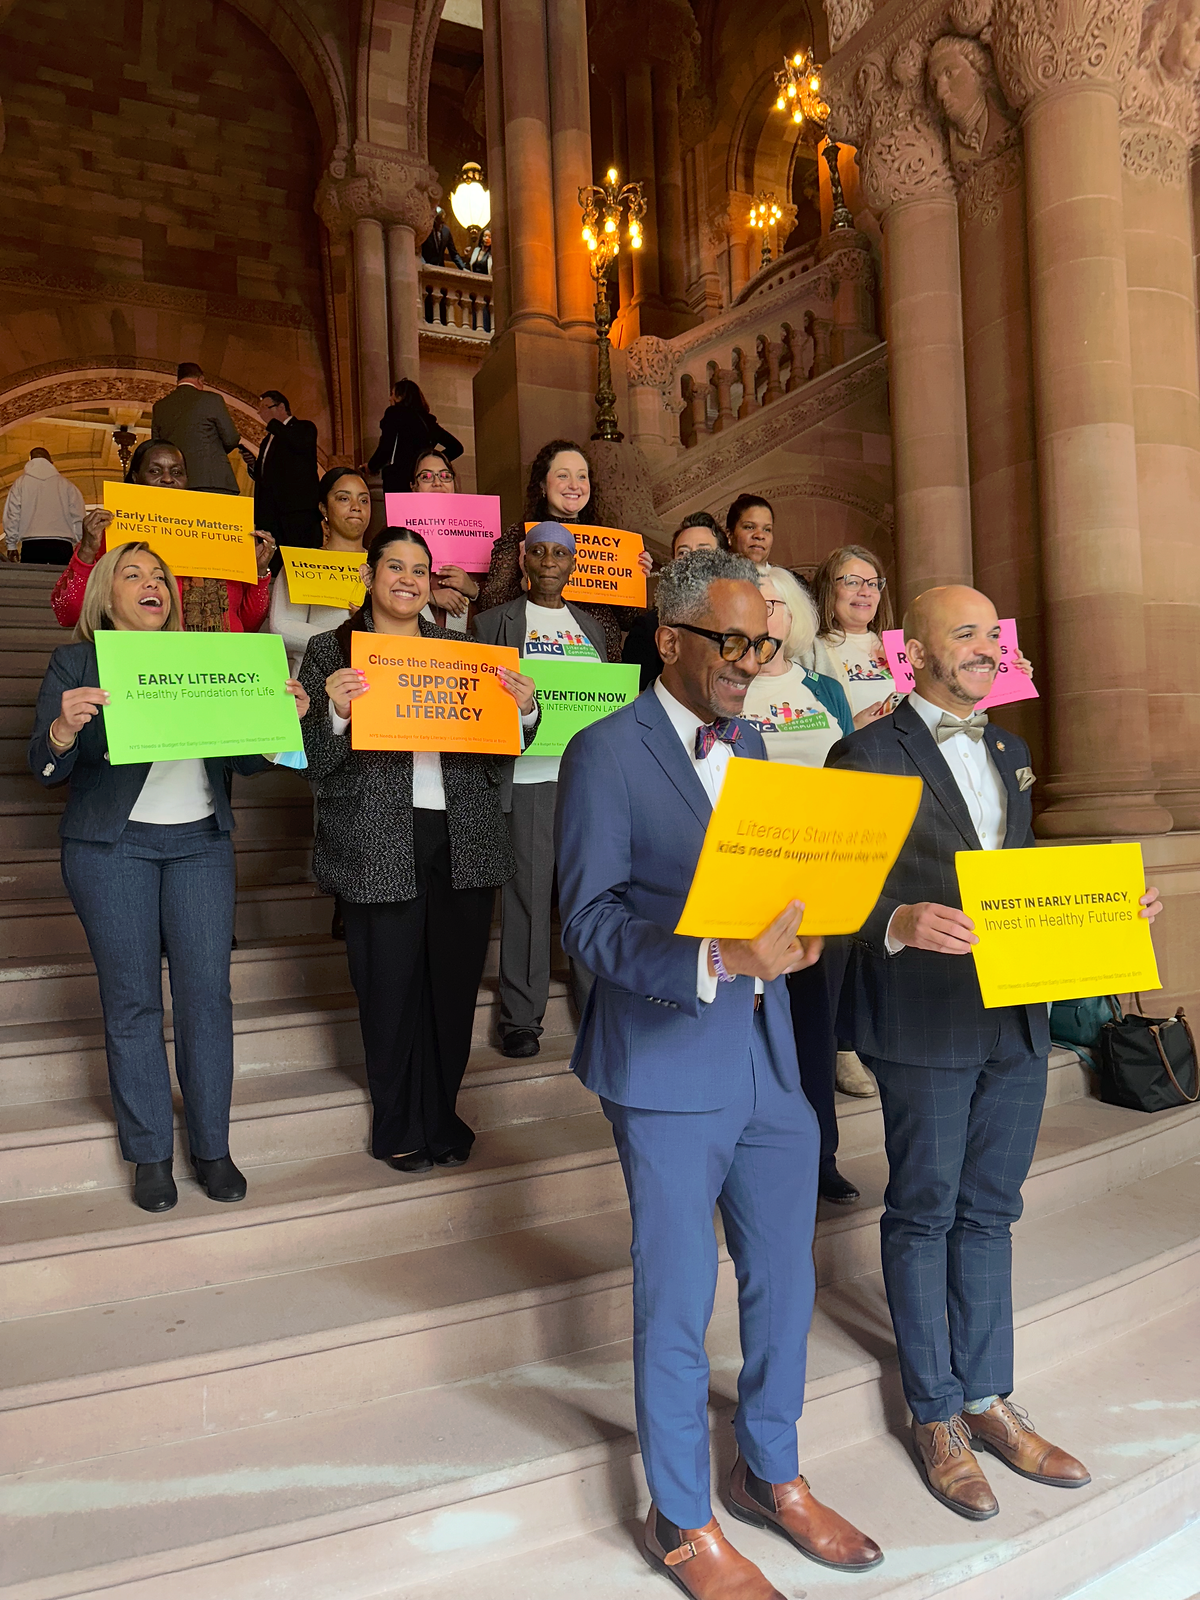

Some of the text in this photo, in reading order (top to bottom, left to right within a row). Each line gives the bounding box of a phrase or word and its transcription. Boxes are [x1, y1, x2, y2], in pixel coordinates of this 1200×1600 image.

[116, 509, 243, 532] Early Literacy Matters:
[449, 519, 485, 528] READERS,
[116, 522, 244, 544] INVEST IN OUR FUTURE
[438, 529, 494, 538] COMMUNITIES
[574, 533, 621, 547] ERACY
[575, 549, 618, 562] OWER:
[291, 561, 345, 572] Literacy
[608, 567, 632, 578] OUR
[295, 571, 322, 579] NOT
[567, 577, 618, 590] HILDREN
[529, 644, 562, 653] LINC
[368, 654, 404, 667] Close
[407, 657, 427, 668] the
[430, 658, 478, 673] Reading
[138, 673, 260, 685] EARLY LITERACY:
[398, 674, 480, 691] SUPPORT
[126, 686, 275, 701] A Healthy Foundation for Life
[412, 690, 467, 705] EARLY
[535, 690, 626, 703] EVENTION NOW
[396, 704, 483, 721] LITERACY
[546, 703, 601, 712] INTERVENTION
[749, 723, 774, 732] NC
[736, 820, 800, 843] Literacy
[803, 826, 842, 845] Starts
[716, 841, 745, 855] kids
[748, 844, 782, 858] need
[784, 849, 830, 864] support
[980, 891, 1131, 911] INVEST IN EARLY LITERACY,
[985, 910, 1132, 931] Invest in Healthy Futures
